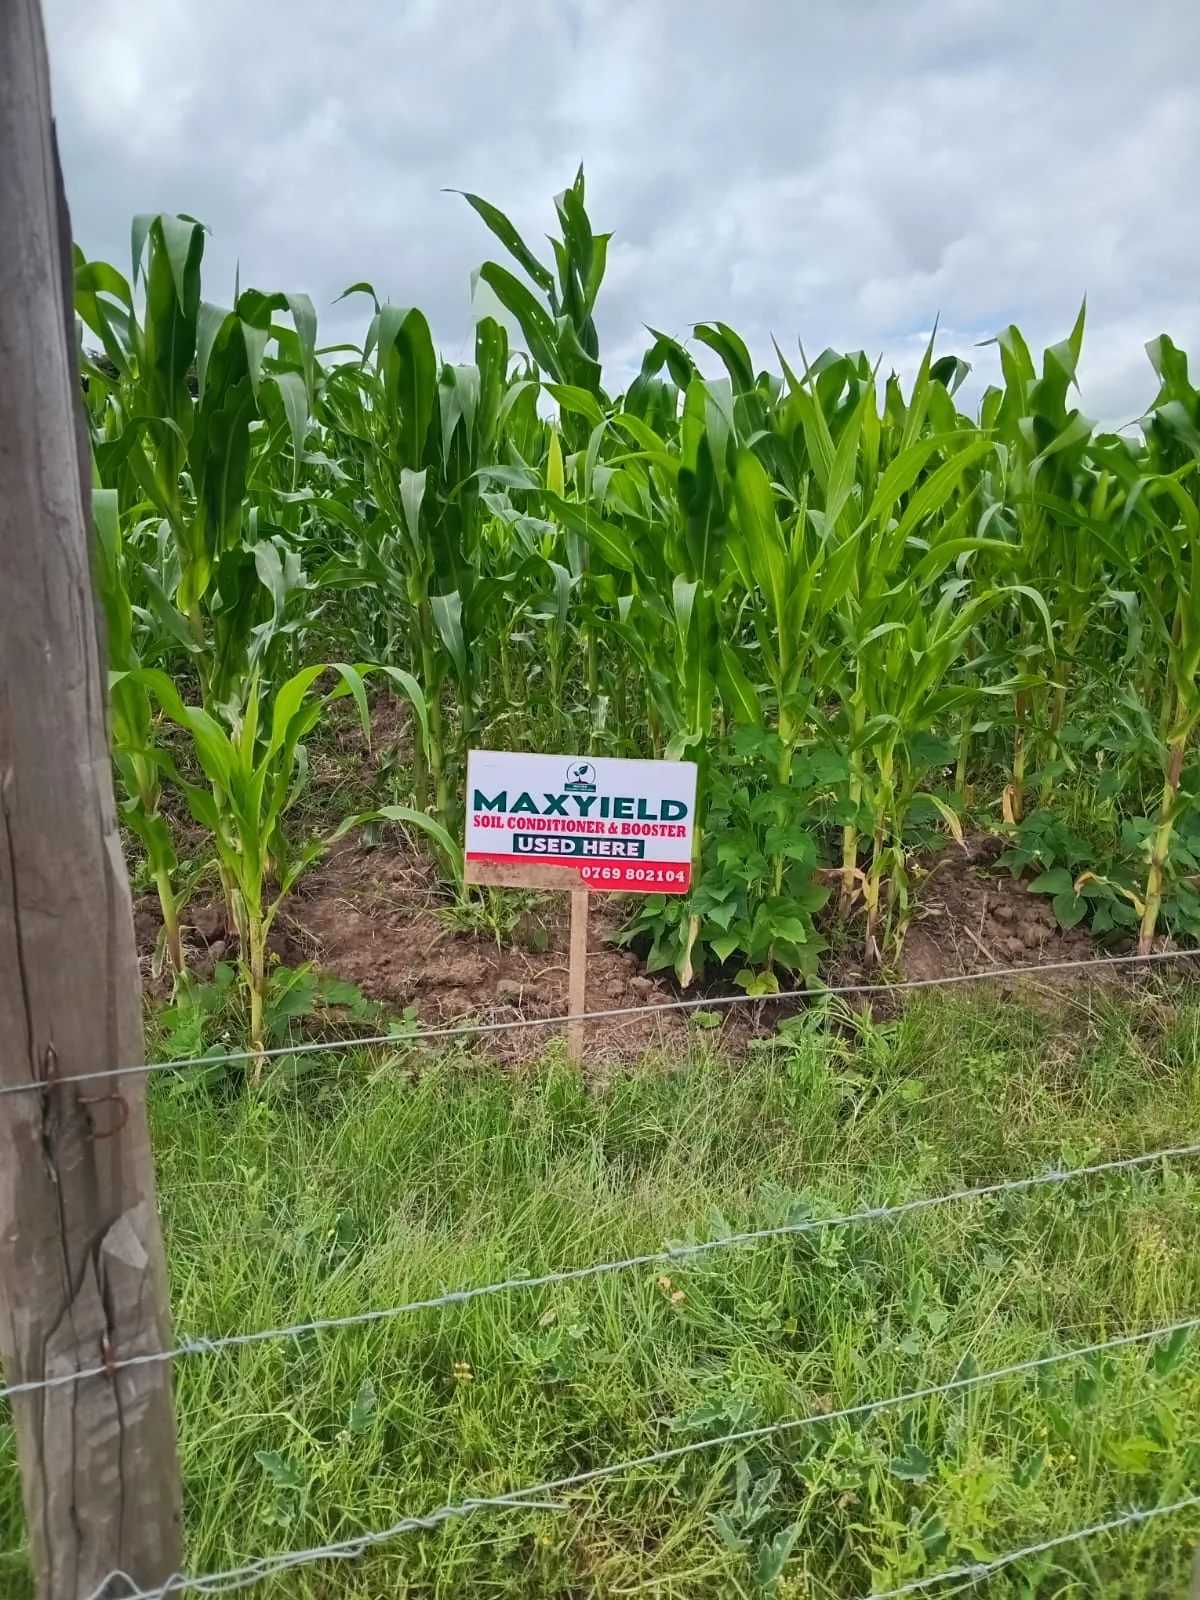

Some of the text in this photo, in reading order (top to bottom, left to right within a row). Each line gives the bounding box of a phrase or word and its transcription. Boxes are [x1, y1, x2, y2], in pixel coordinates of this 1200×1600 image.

[473, 789, 688, 821] MAXYIELD
[473, 814, 686, 838] SOIL CONDITIONER & BOOSTER
[518, 837, 639, 857] USED HERE
[581, 866, 685, 883] 0769 802104
